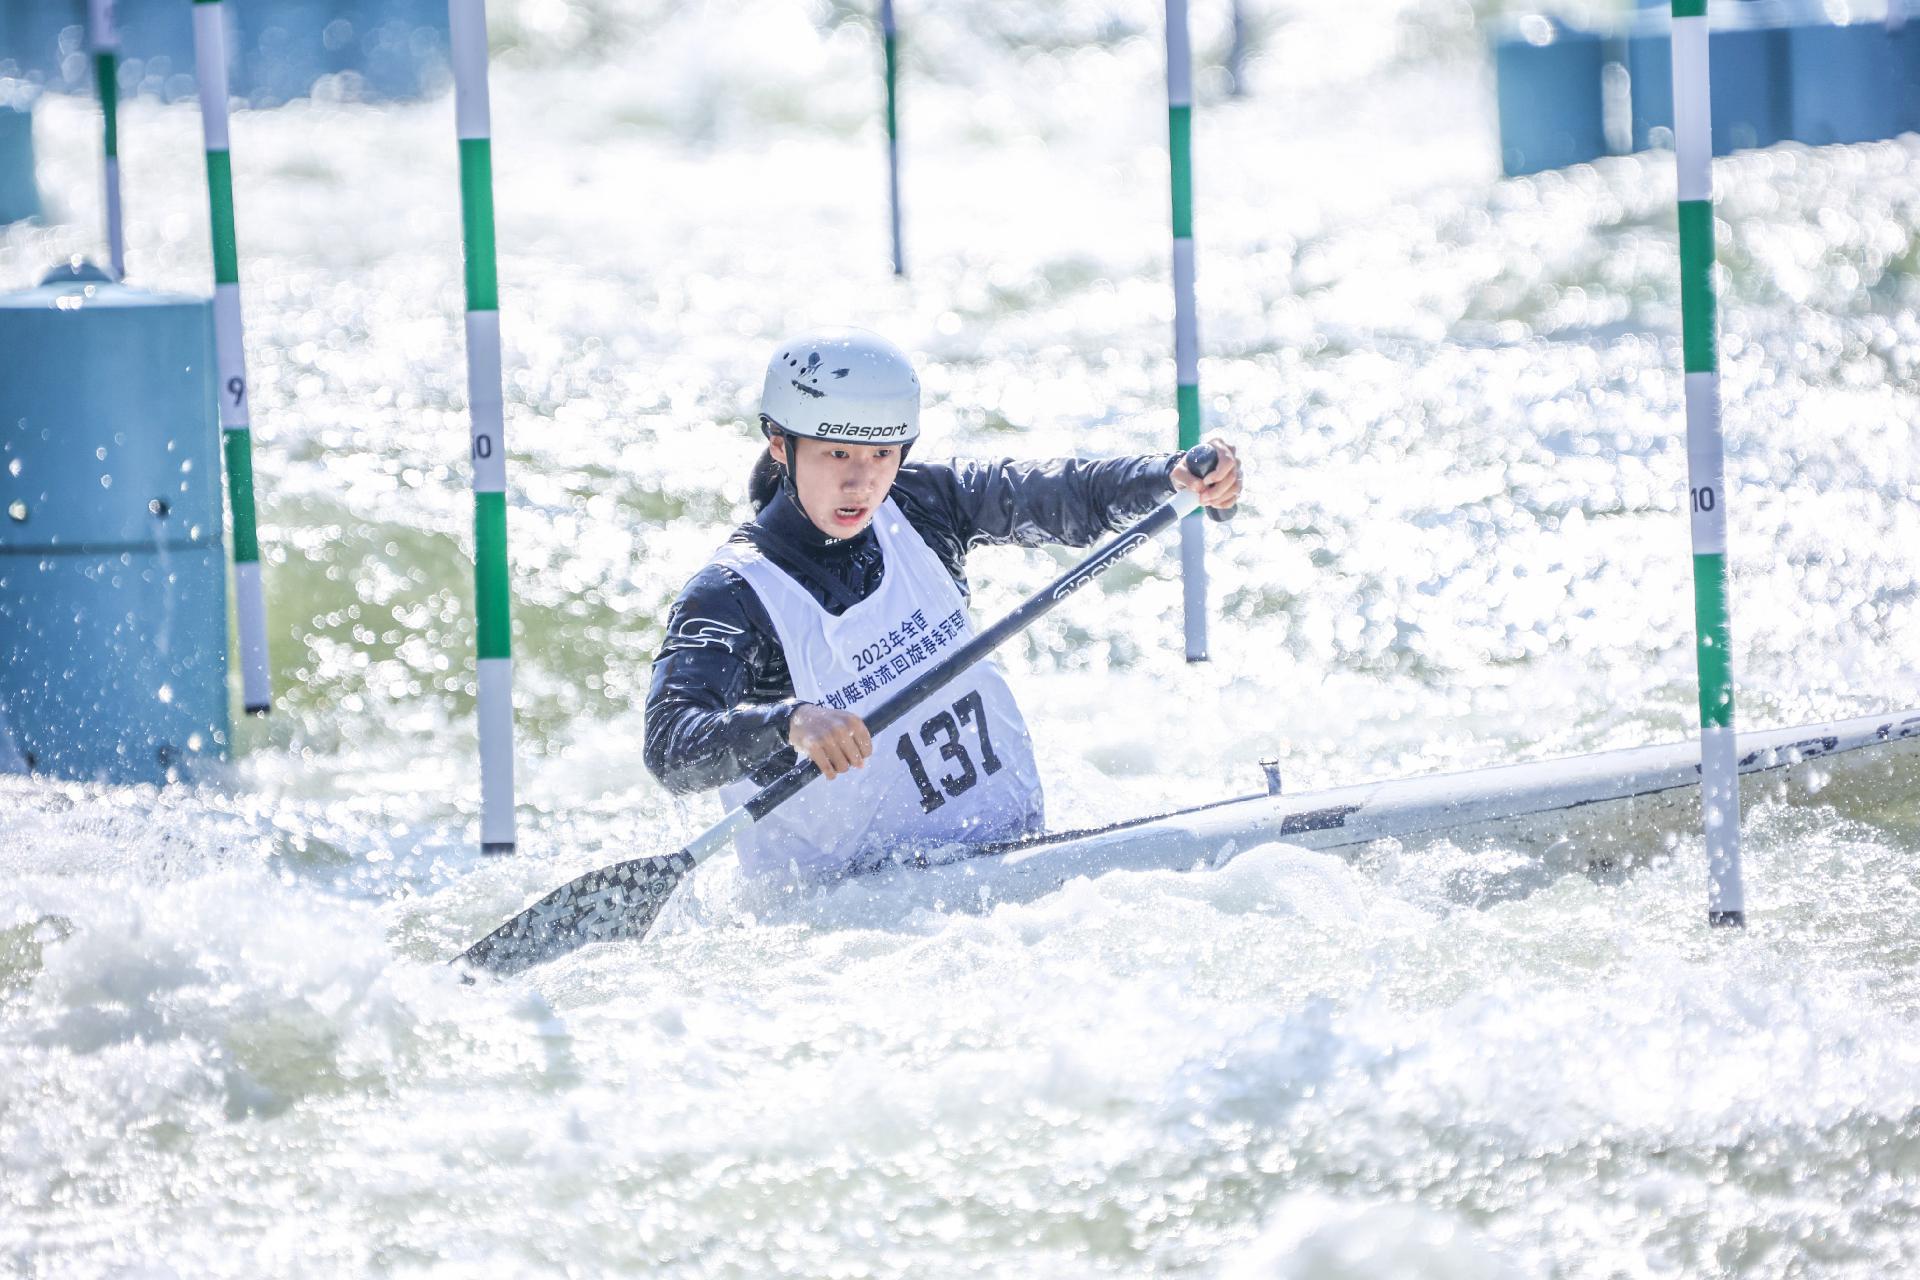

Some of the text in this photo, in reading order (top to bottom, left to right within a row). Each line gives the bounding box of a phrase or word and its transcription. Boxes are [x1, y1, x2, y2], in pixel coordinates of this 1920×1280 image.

[228, 376, 244, 407] 9
[815, 422, 907, 440] galasport
[1690, 486, 1716, 513] 10
[896, 689, 1002, 815] 137
